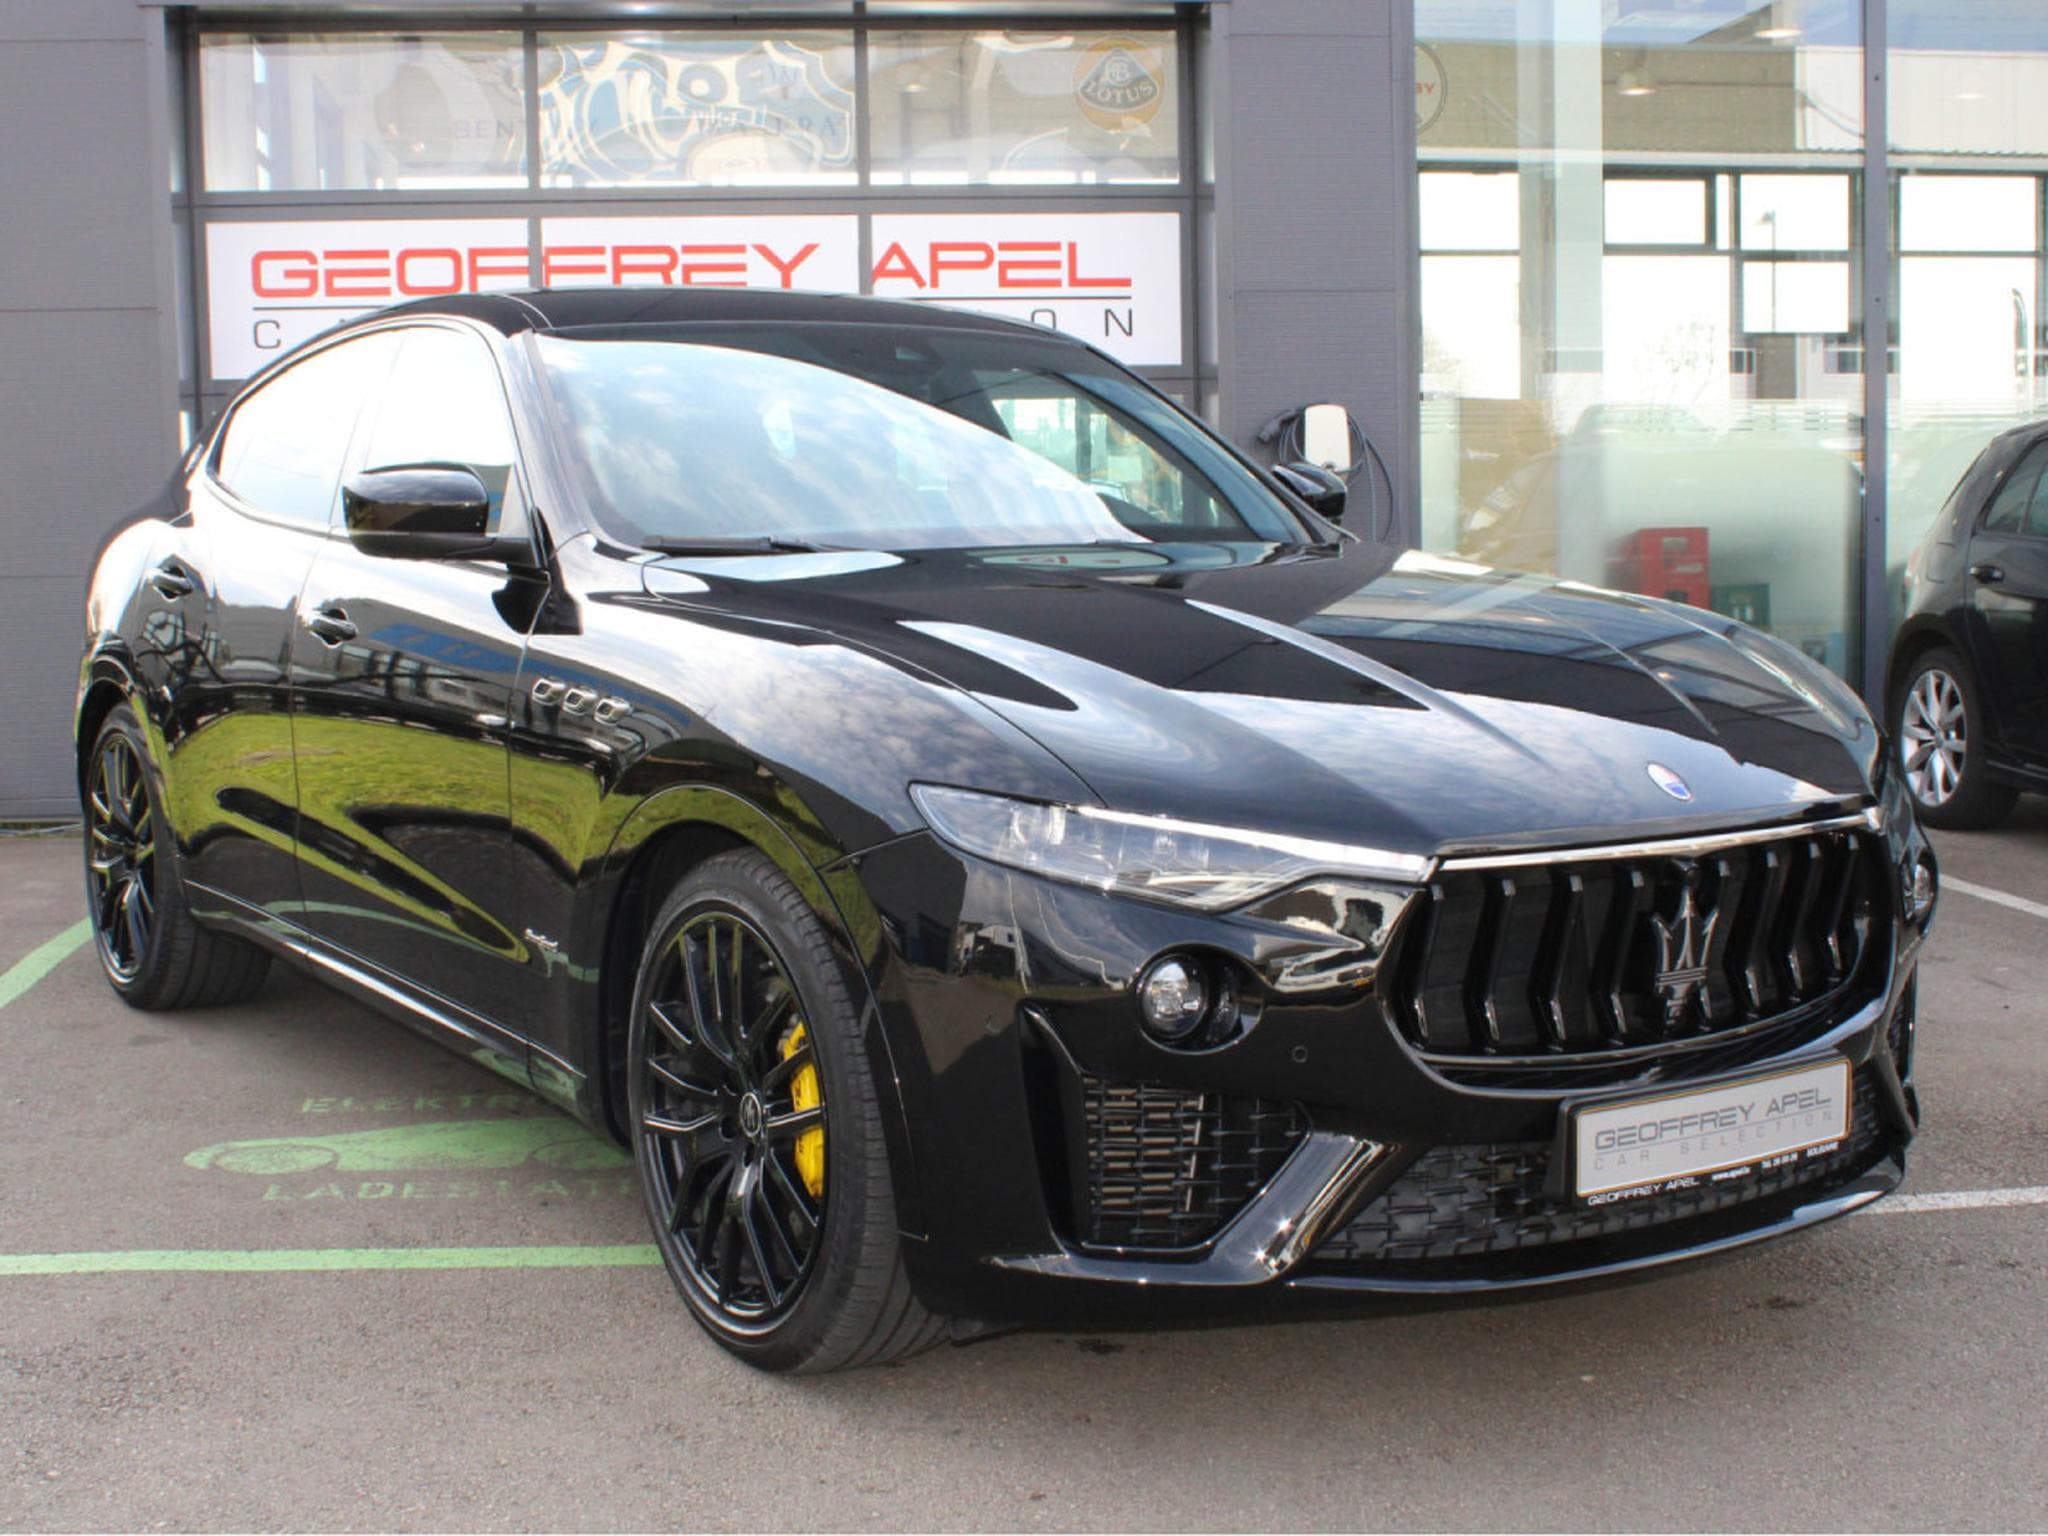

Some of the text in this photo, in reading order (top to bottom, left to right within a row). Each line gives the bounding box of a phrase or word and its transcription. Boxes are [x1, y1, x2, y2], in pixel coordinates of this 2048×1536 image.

[1081, 80, 1155, 103] LOTUS
[252, 241, 1132, 297] GEOFFREY APEL
[1594, 1149, 1650, 1170] CAR
[1680, 1109, 1832, 1155] SELECTION
[1595, 1087, 1832, 1150] GEOFFREY APEL
